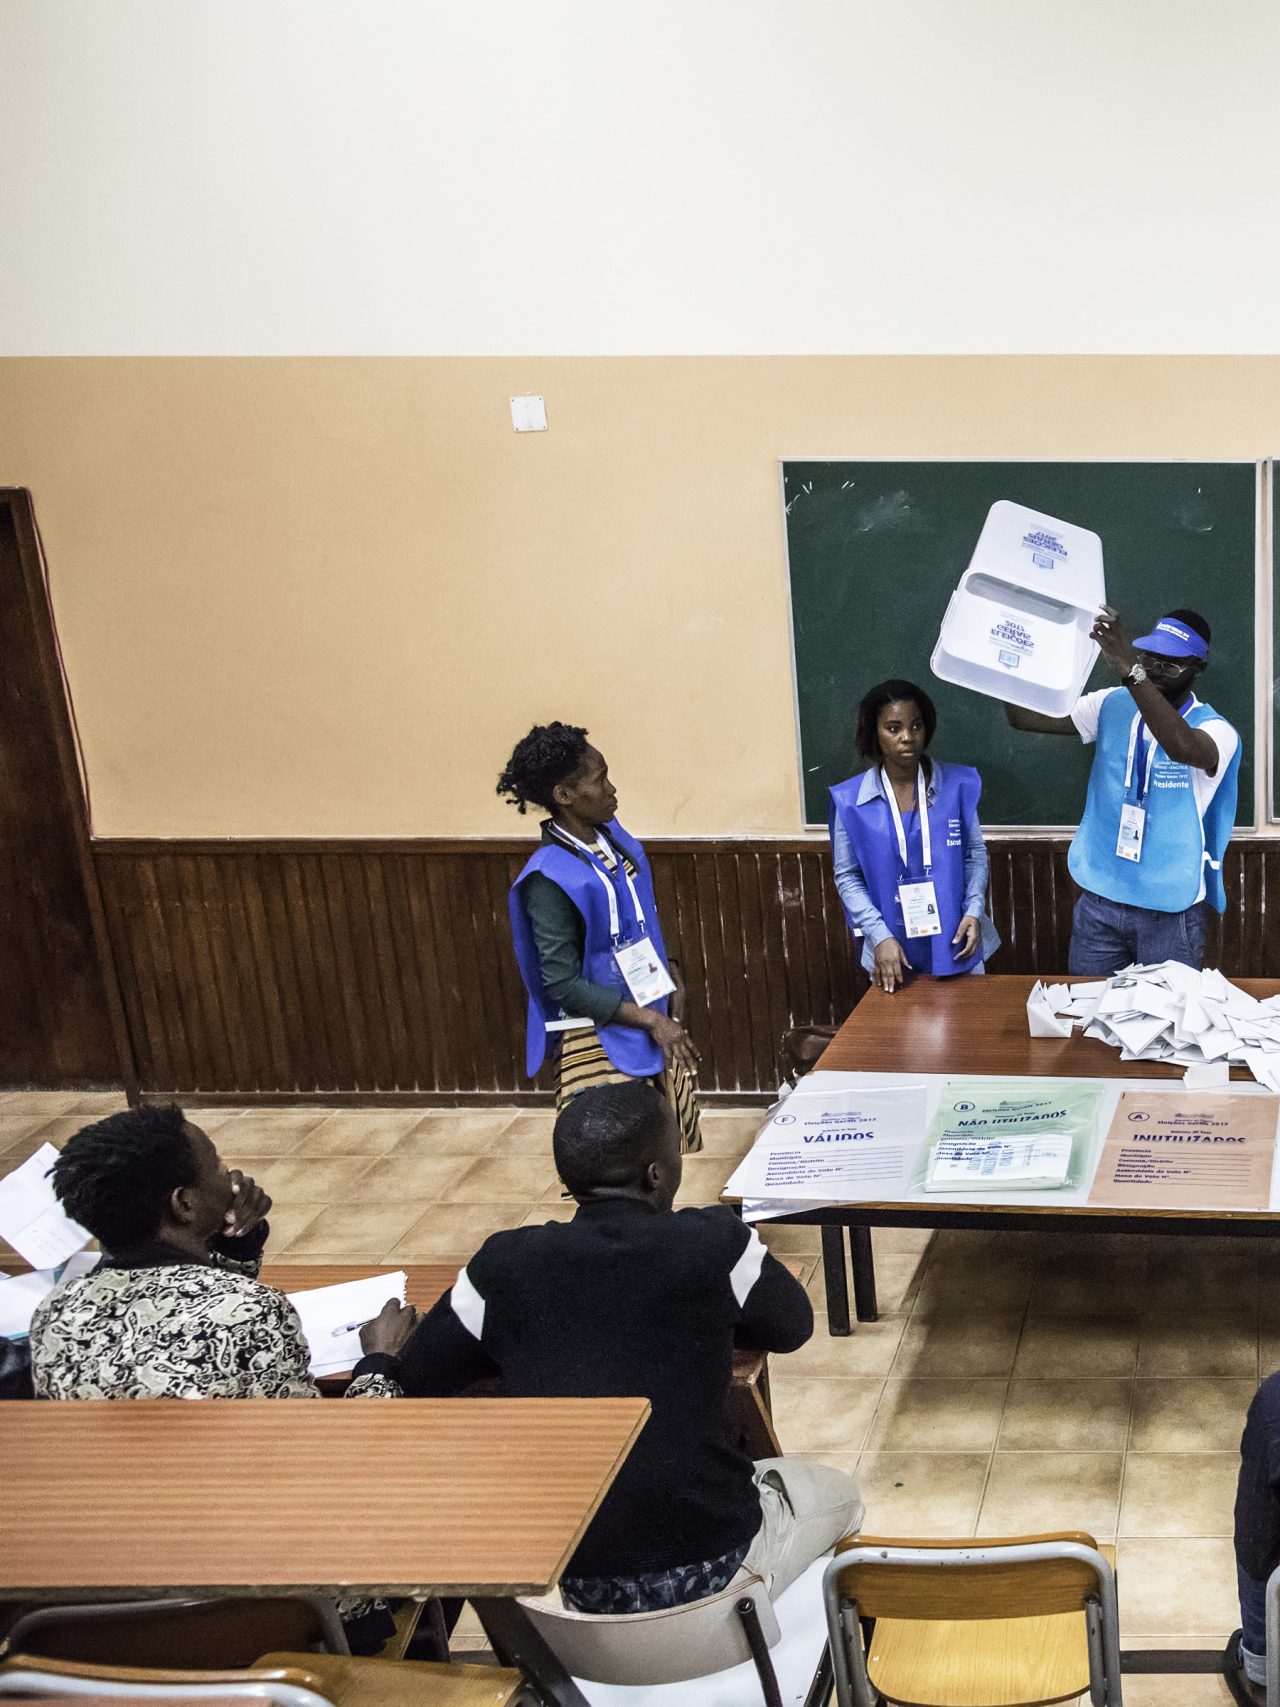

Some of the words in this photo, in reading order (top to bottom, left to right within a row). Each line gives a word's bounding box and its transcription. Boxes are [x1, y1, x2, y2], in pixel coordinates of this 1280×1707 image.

[958, 1119, 987, 1127] NÃO
[803, 1132, 874, 1143] VÁLIDOS
[1133, 1134, 1246, 1143] INUTILIZADOS
